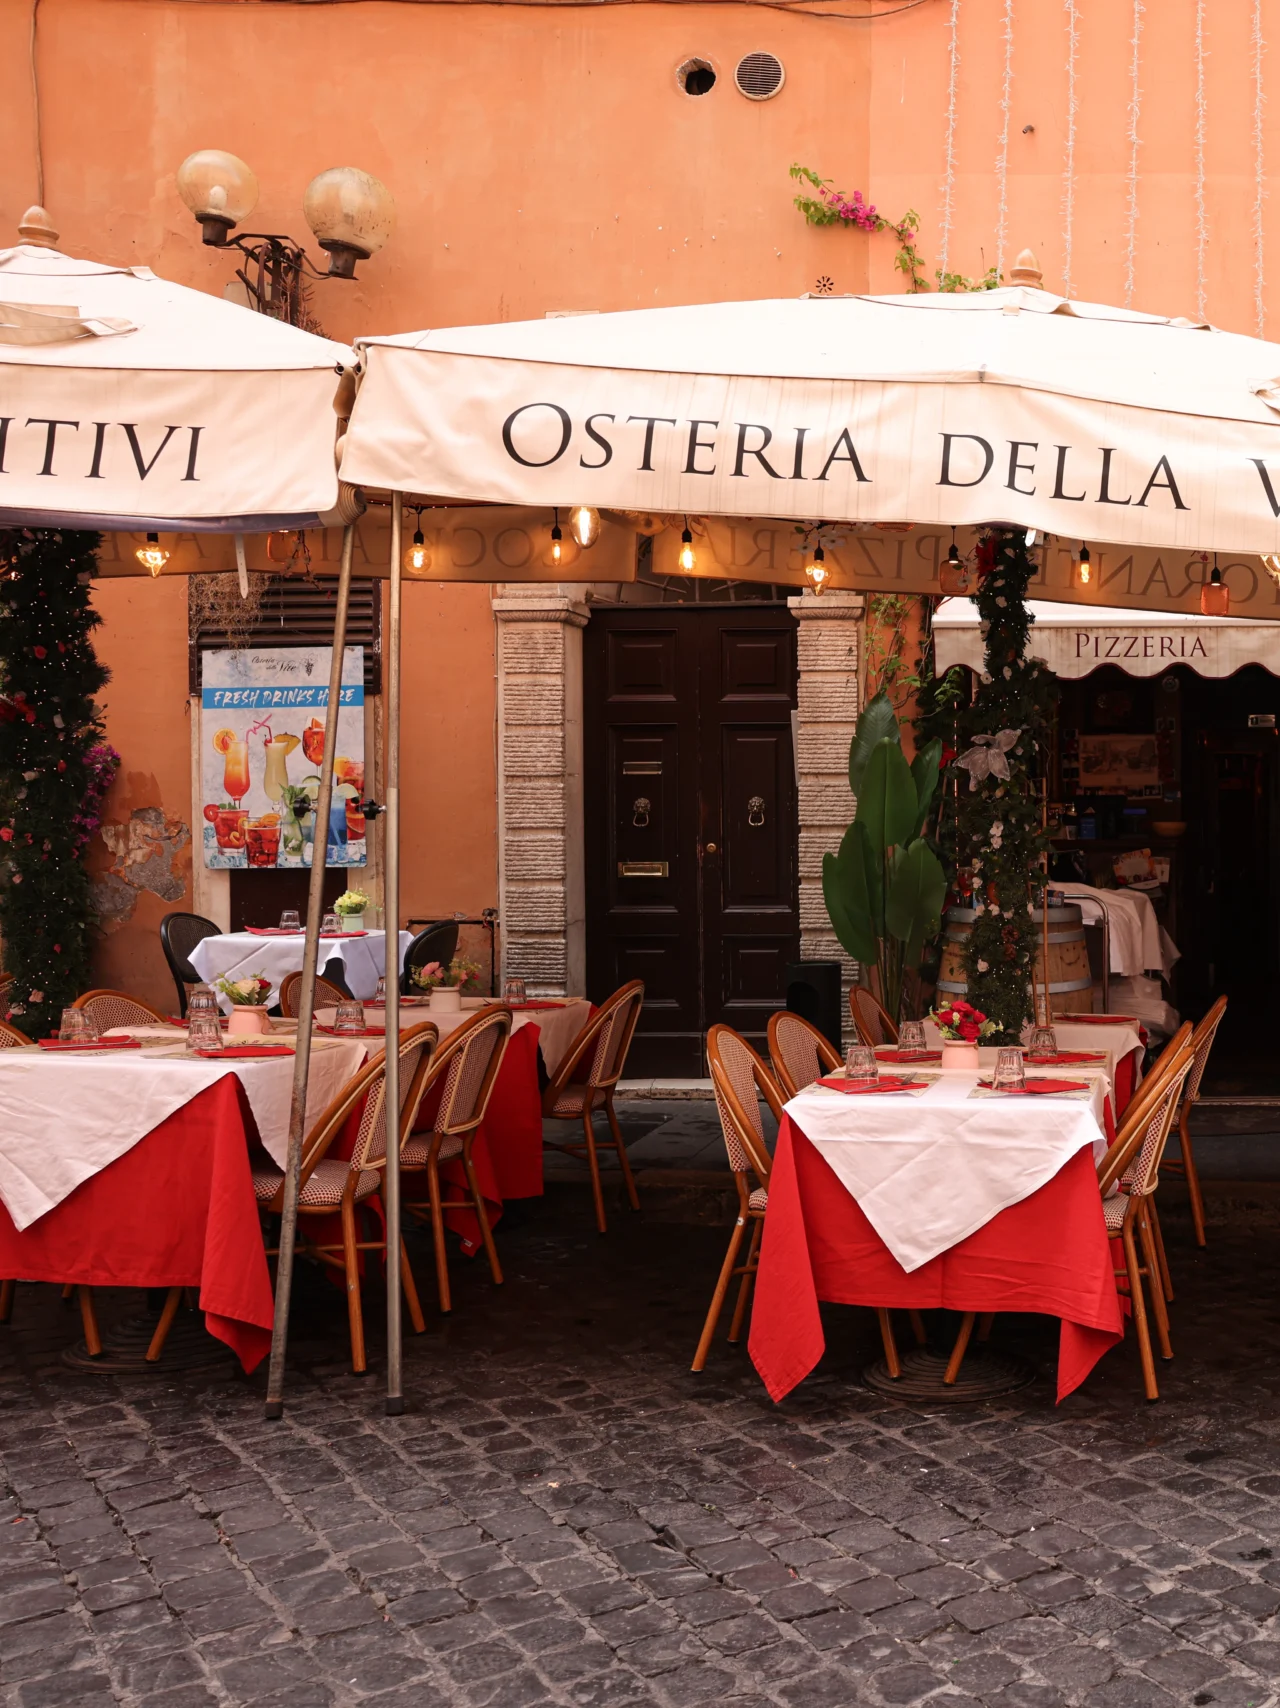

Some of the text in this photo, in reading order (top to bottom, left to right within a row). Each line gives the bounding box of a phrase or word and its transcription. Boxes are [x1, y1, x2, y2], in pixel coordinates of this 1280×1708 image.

[502, 402, 874, 484] OSTERIA
[935, 432, 1192, 512] DELLA
[1074, 632, 1209, 658] PIZZERIA
[213, 687, 356, 708] FRESH DRINKS HRE
